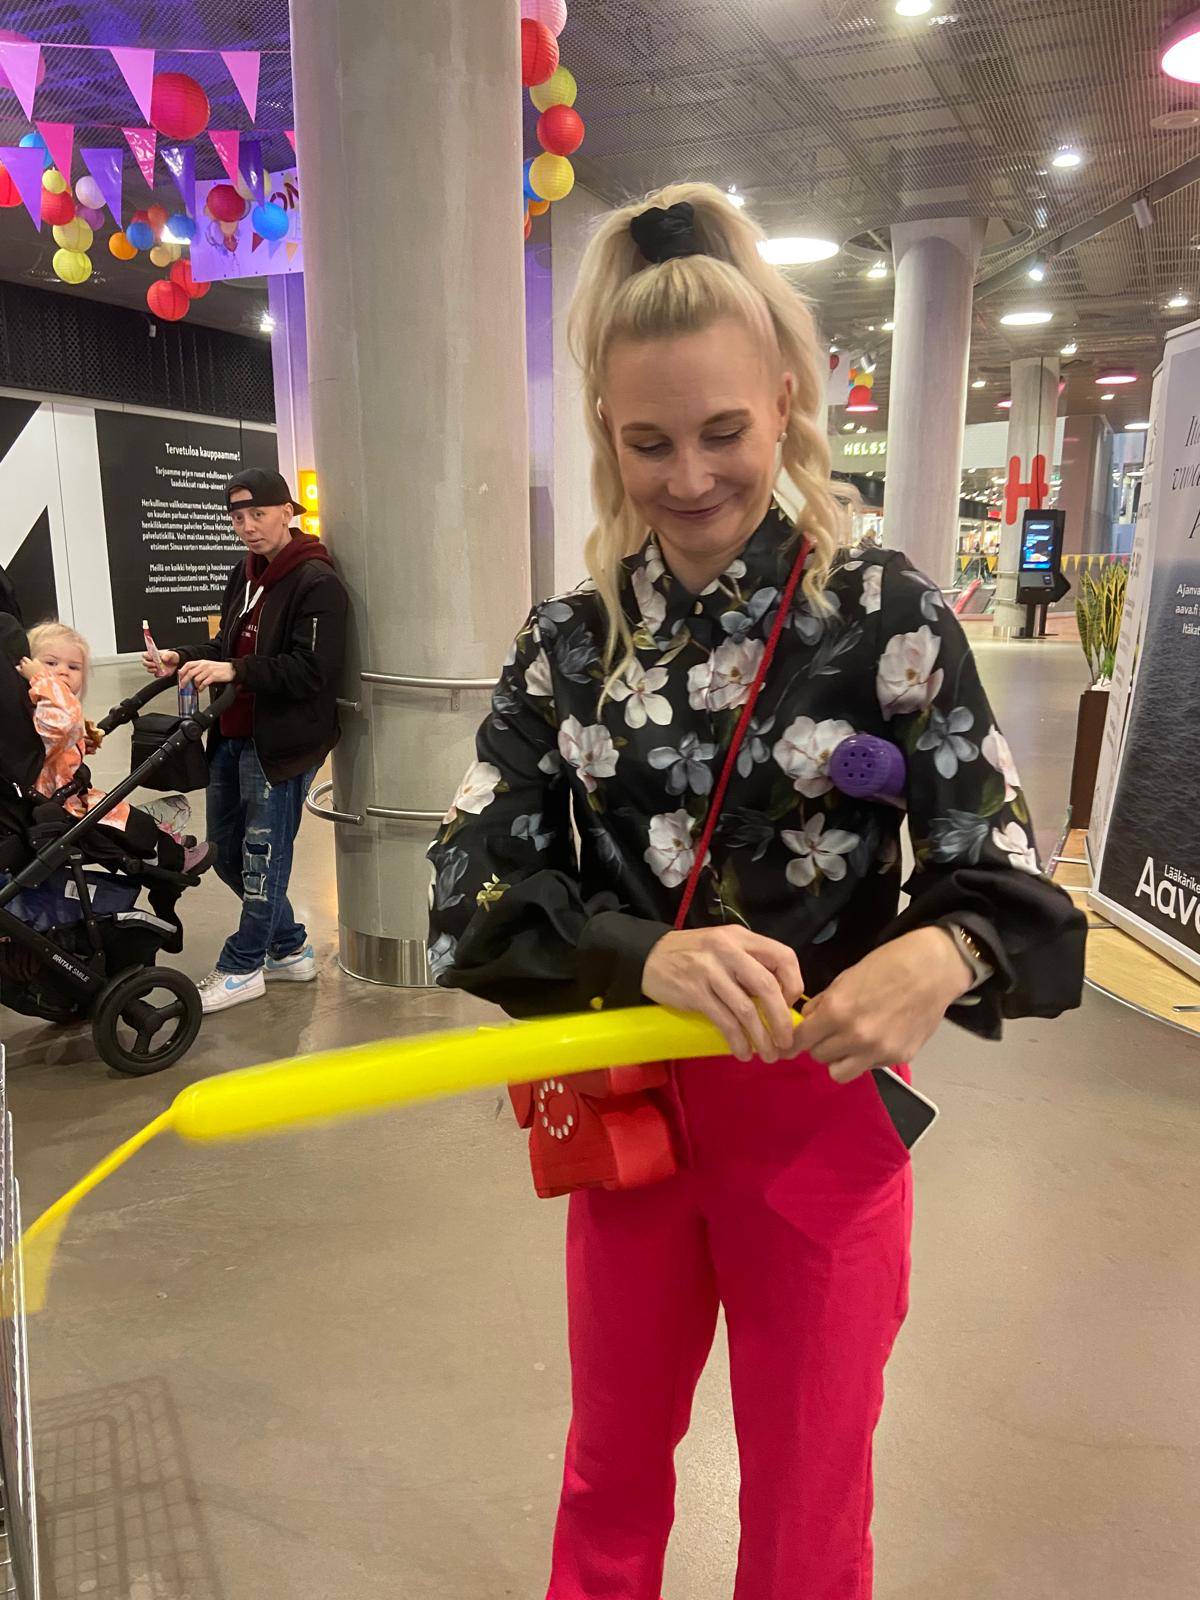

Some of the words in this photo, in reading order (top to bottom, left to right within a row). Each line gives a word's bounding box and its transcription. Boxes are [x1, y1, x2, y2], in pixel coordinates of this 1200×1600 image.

[165, 442, 199, 457] Tervetuloa
[199, 446, 240, 461] kauppaamme!
[141, 498, 169, 508] Herkullinen
[176, 615, 188, 624] Mika
[52, 953, 74, 971] BRITAX
[71, 967, 90, 983] SMILE
